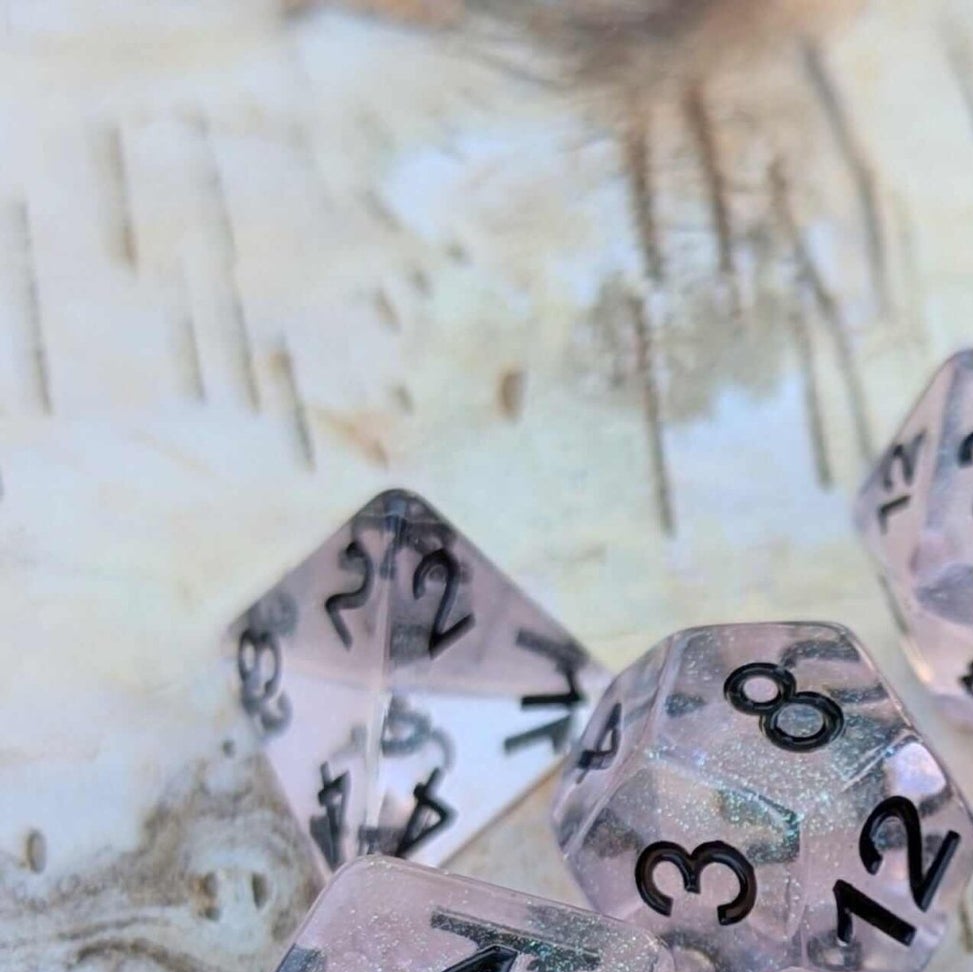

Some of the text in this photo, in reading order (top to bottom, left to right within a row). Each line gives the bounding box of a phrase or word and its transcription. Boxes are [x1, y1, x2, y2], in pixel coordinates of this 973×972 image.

[413, 548, 477, 660] 2
[723, 661, 846, 753] 8
[635, 840, 757, 927] 3
[832, 795, 961, 947] 12
